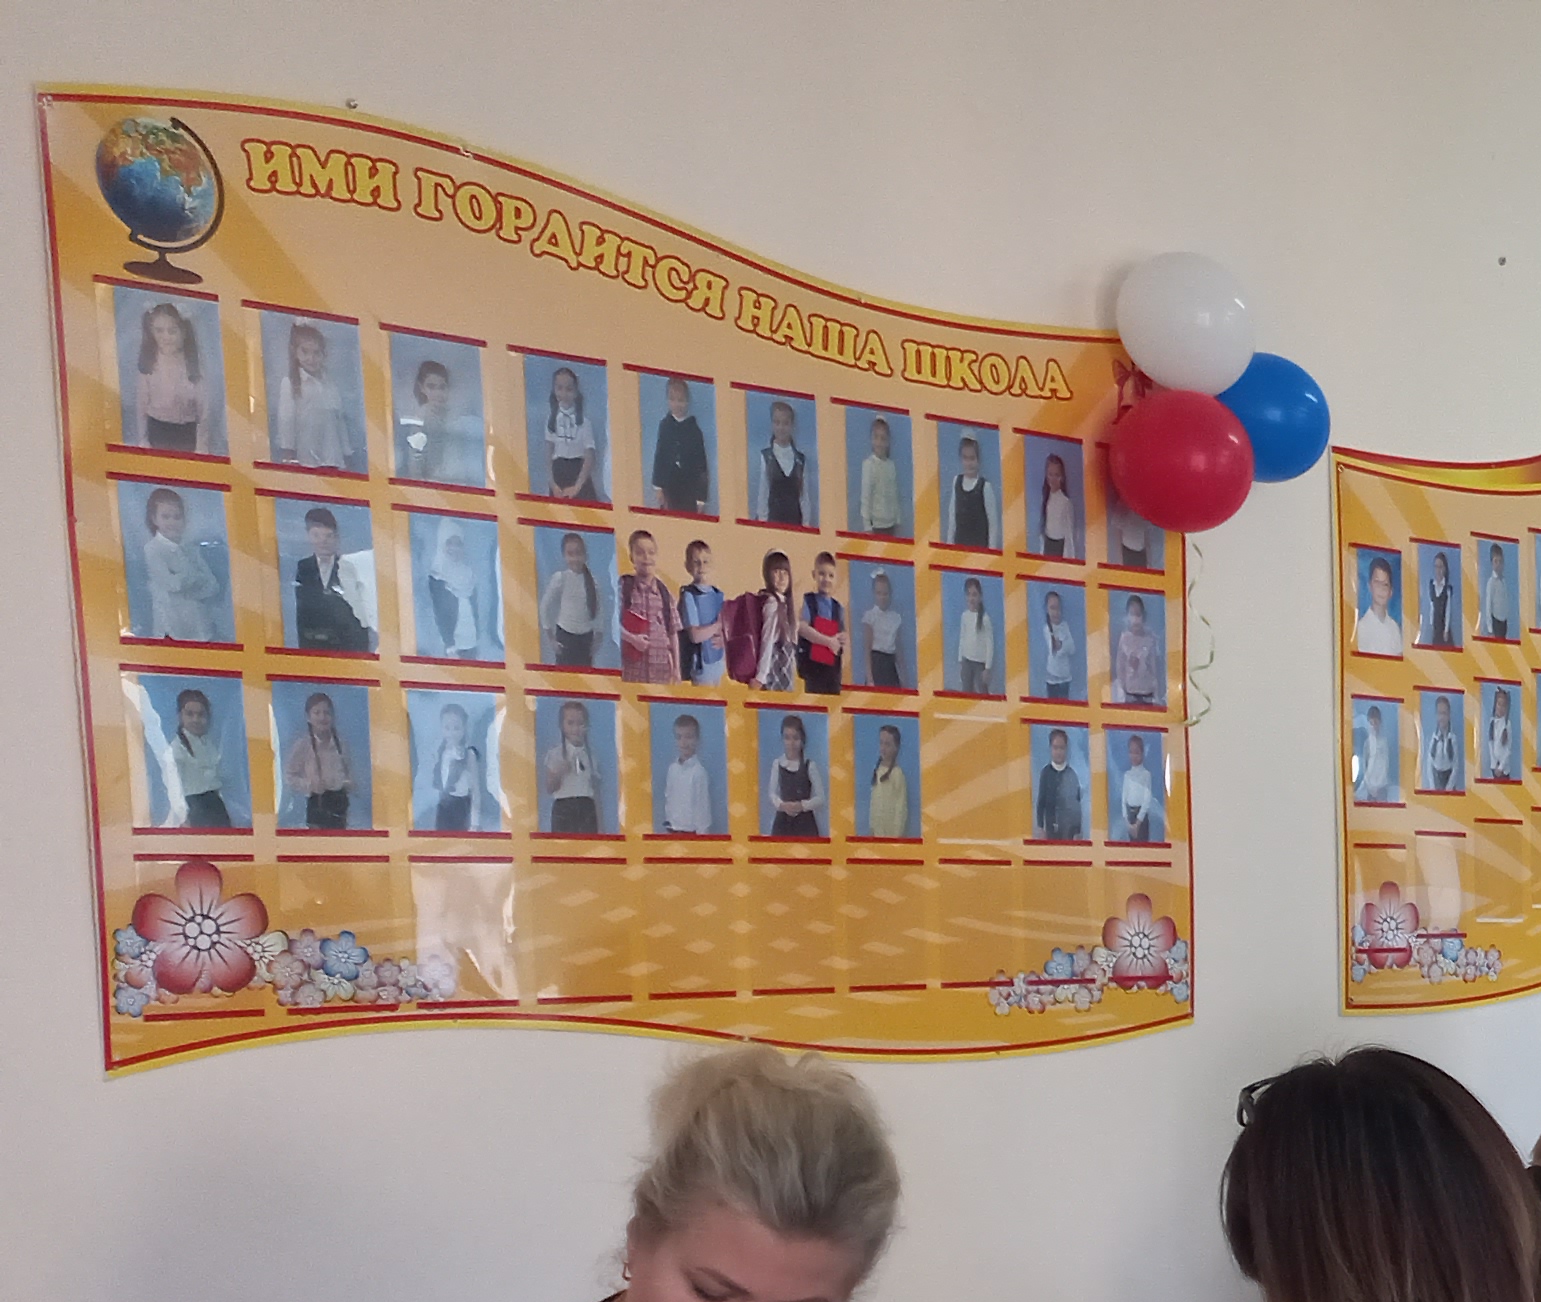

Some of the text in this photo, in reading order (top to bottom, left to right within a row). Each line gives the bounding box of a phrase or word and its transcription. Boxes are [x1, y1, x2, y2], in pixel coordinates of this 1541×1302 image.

[241, 138, 1073, 401] ИМИ ГОРДИТСЯ НАША ШКОЛА
